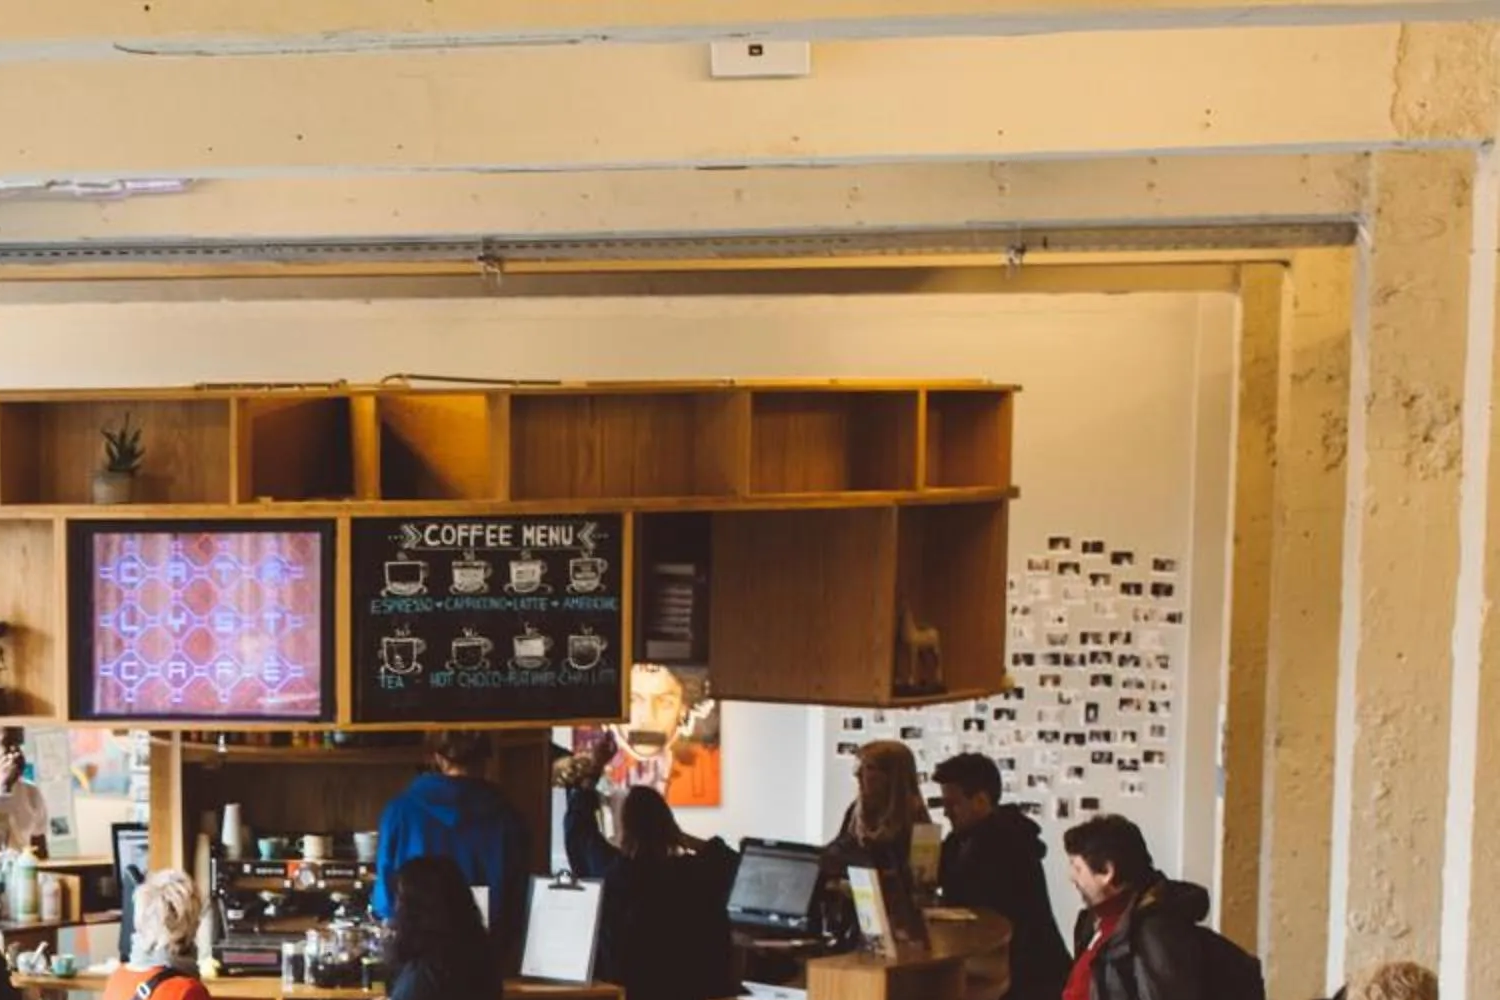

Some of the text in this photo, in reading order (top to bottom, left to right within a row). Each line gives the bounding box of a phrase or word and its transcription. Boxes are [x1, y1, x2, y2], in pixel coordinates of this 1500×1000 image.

[424, 524, 574, 547] COFFEE MENU
[377, 666, 404, 688] TEA
